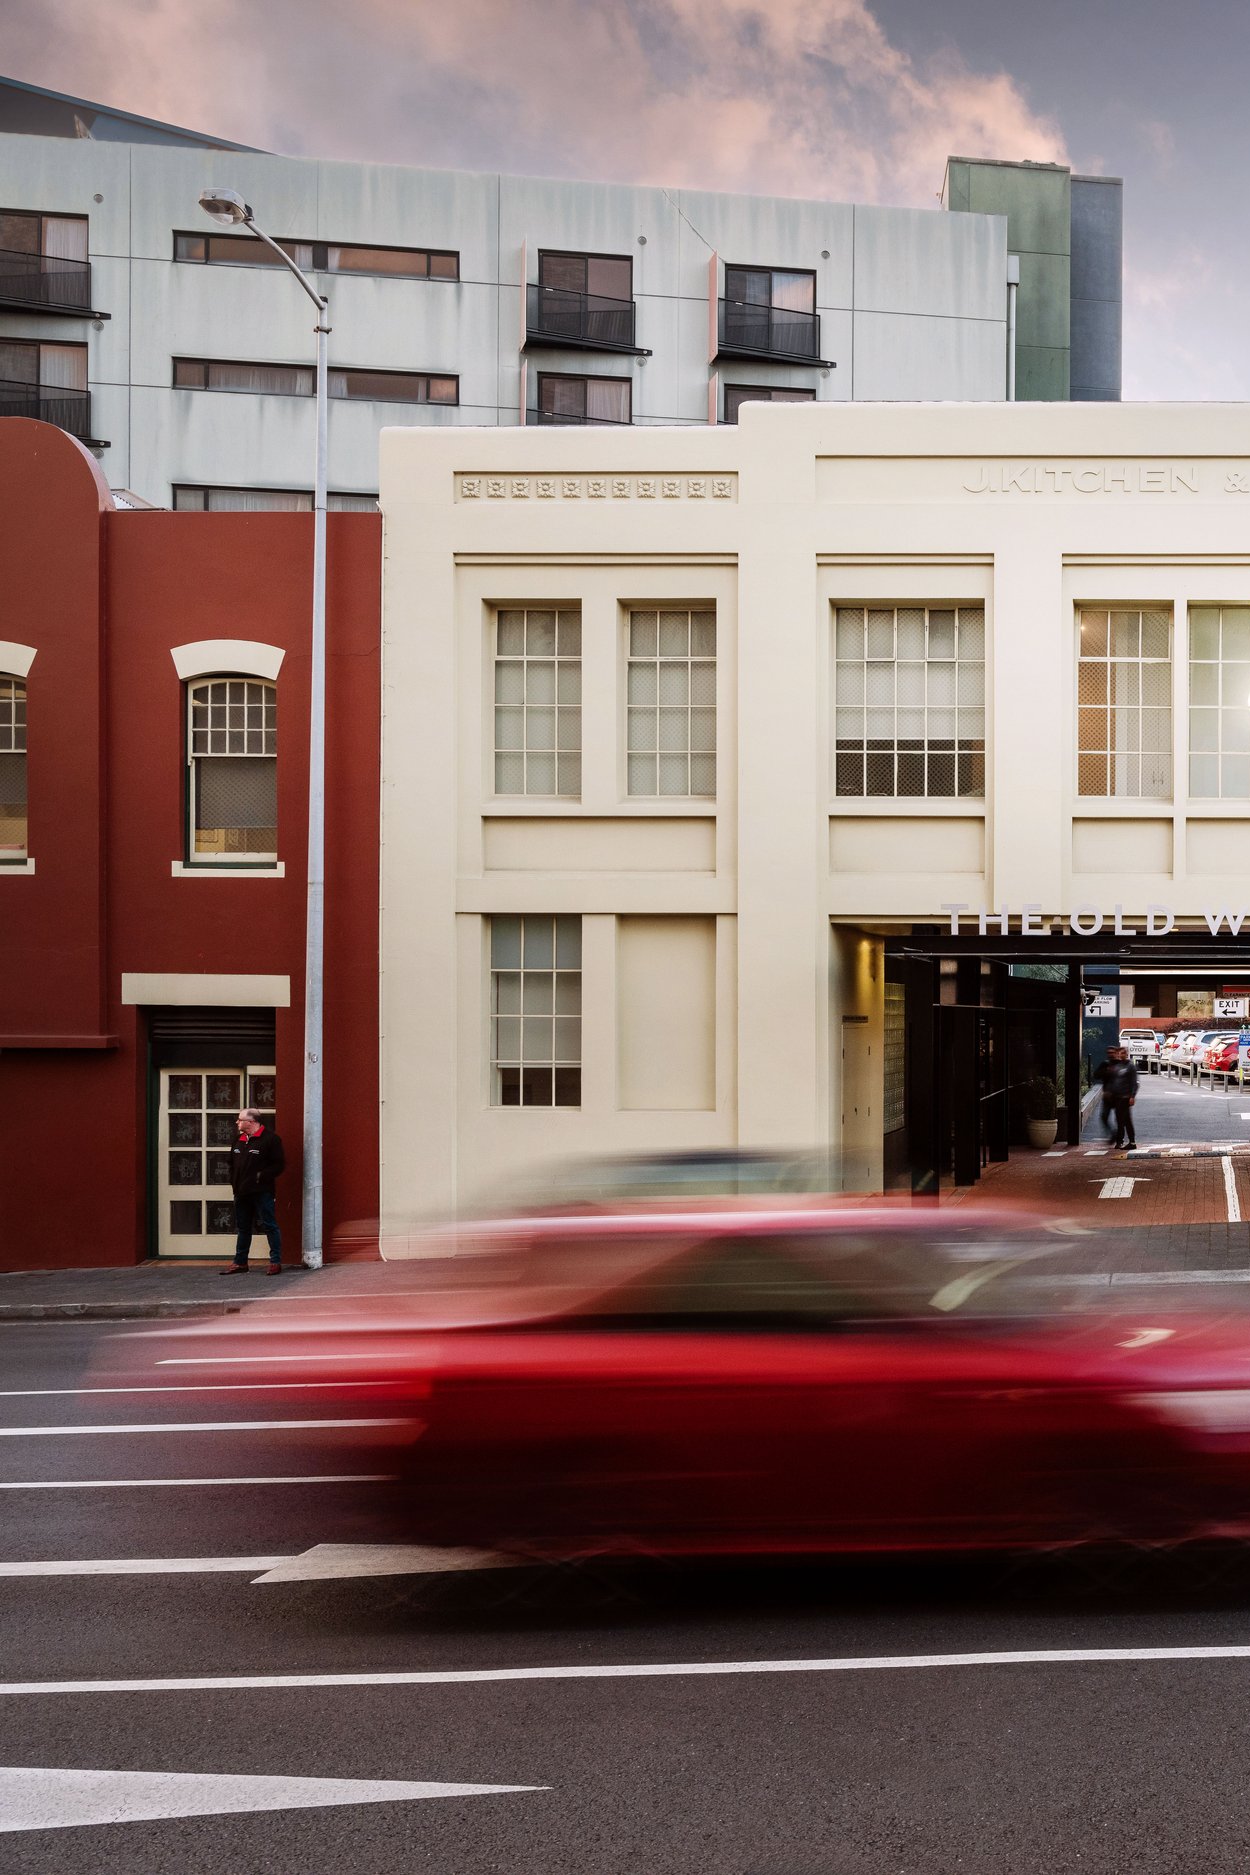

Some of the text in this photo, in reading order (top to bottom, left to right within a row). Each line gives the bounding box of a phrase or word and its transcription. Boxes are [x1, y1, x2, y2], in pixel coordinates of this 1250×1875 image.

[1224, 471, 1250, 493] &
[941, 904, 1043, 936] THE
[1070, 904, 1175, 936] OLD
